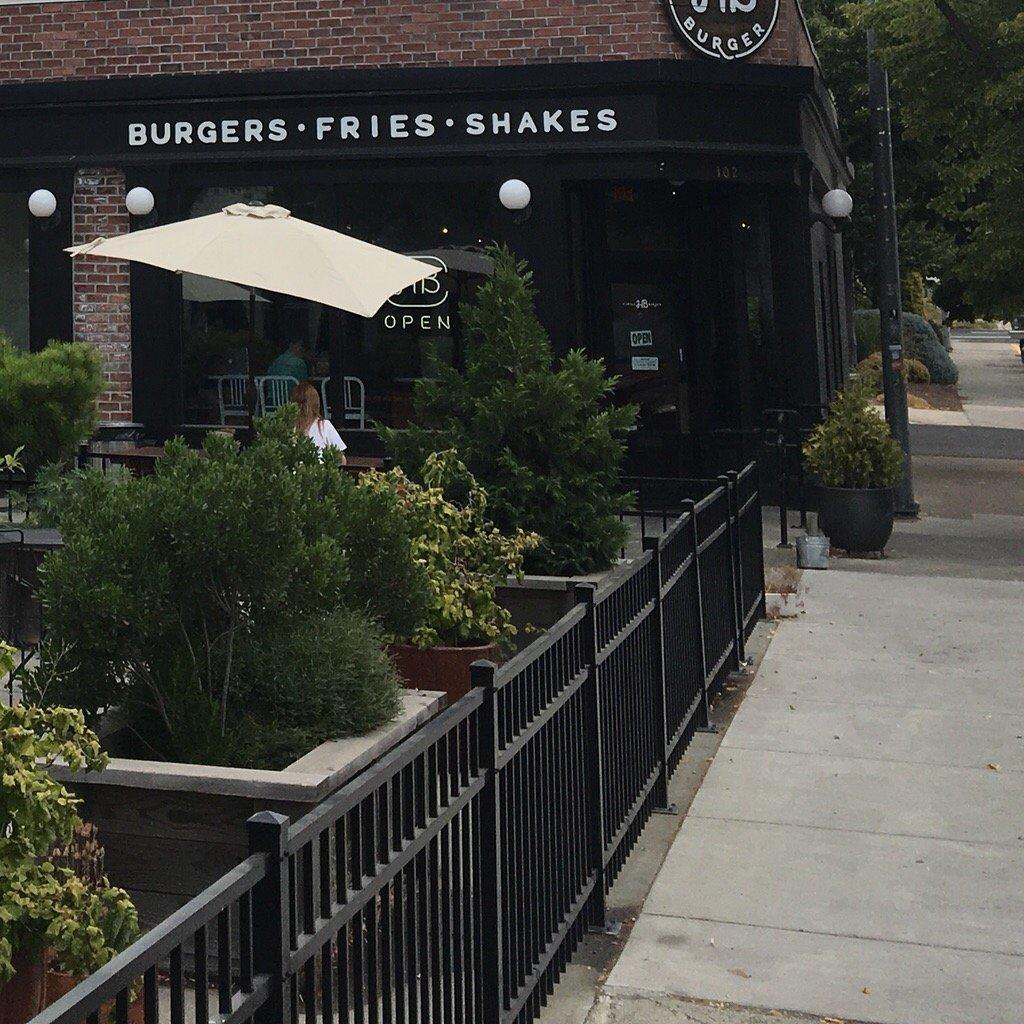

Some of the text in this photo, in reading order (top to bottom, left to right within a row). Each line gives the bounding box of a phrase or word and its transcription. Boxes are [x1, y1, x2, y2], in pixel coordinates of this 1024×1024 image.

[683, 16, 765, 60] BURGER
[128, 107, 618, 146] BURGERS FRIES SHAKES
[384, 314, 451, 330] OPEN
[631, 331, 652, 345] OPEN
